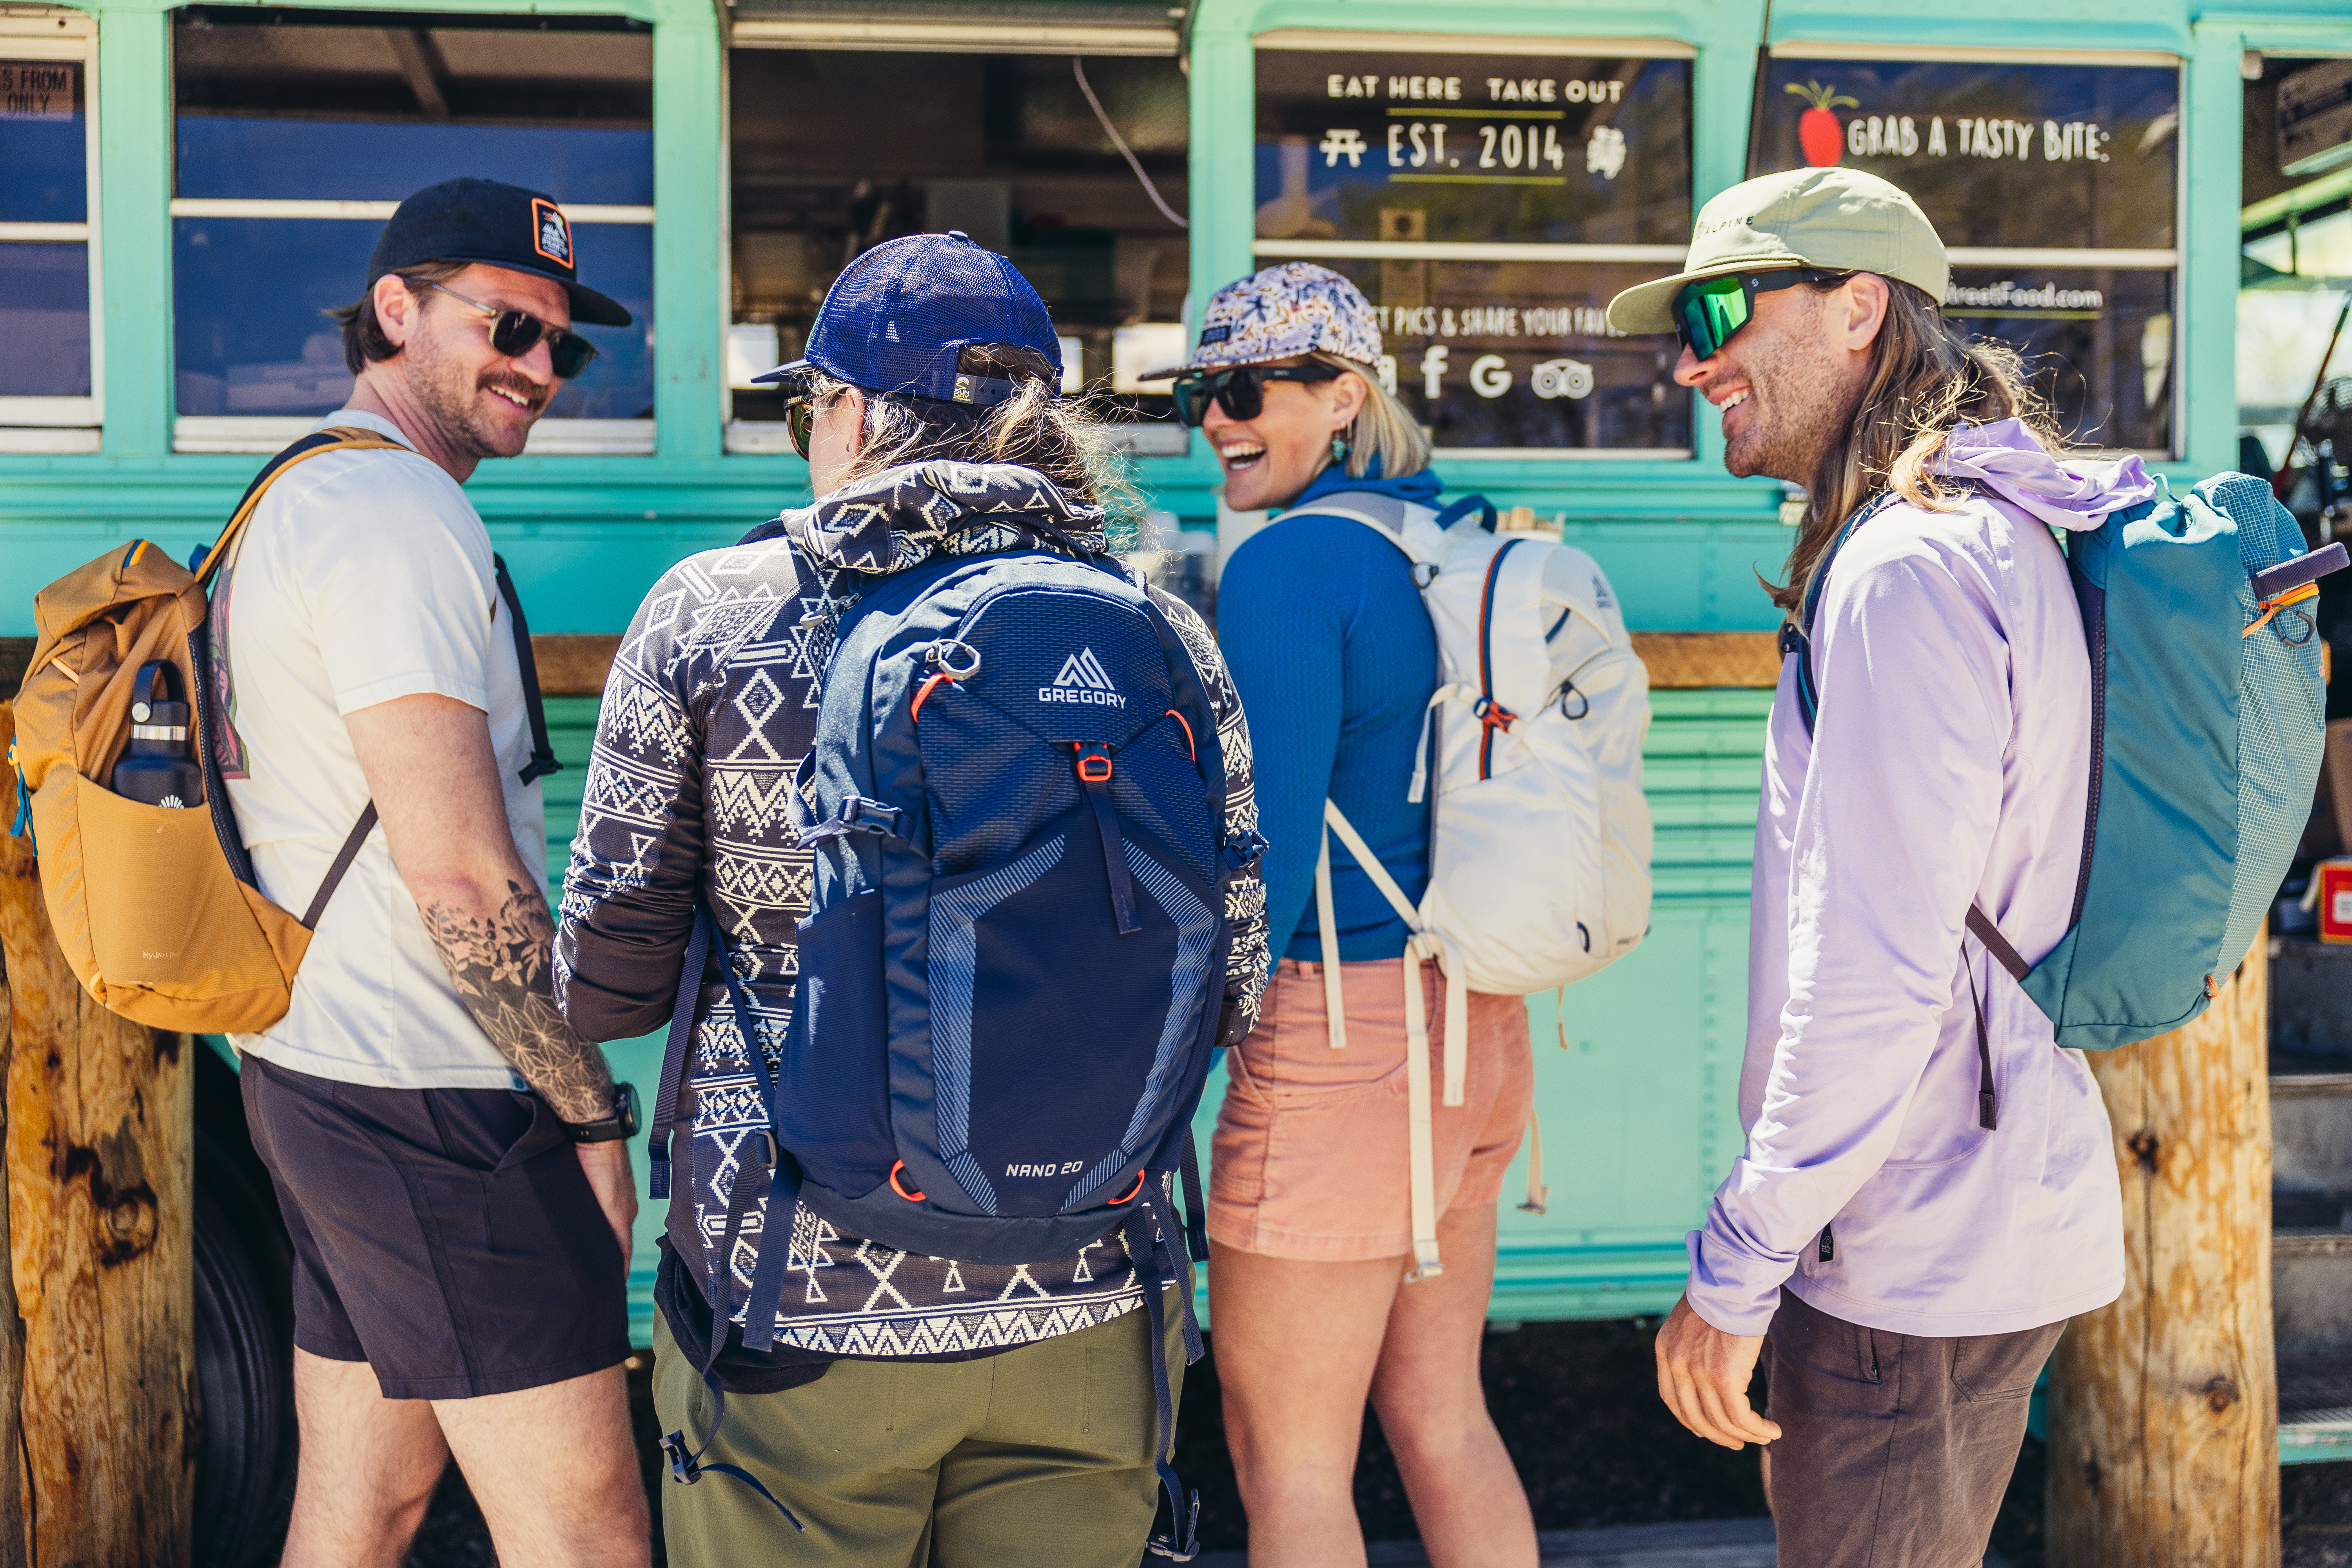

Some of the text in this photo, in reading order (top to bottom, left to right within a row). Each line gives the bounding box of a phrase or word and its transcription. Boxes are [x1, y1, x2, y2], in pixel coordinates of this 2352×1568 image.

[21, 69, 67, 92] FROM
[1327, 74, 1461, 100] EAT HERE
[1486, 77, 1624, 103] TAKE OUT
[7, 93, 50, 114] ONLY
[1387, 122, 1564, 171] EST. 2014
[1847, 115, 2110, 162] GRAB A TASTY BITE:
[1394, 306, 1437, 336] PICS
[1440, 307, 1458, 338] &
[1459, 306, 1519, 336] SHARE
[1521, 307, 1572, 337] YOUR
[788, 395, 802, 405] SMITH
[1039, 688, 1126, 709] GREGORY
[1006, 1161, 1083, 1177] NANO 20
